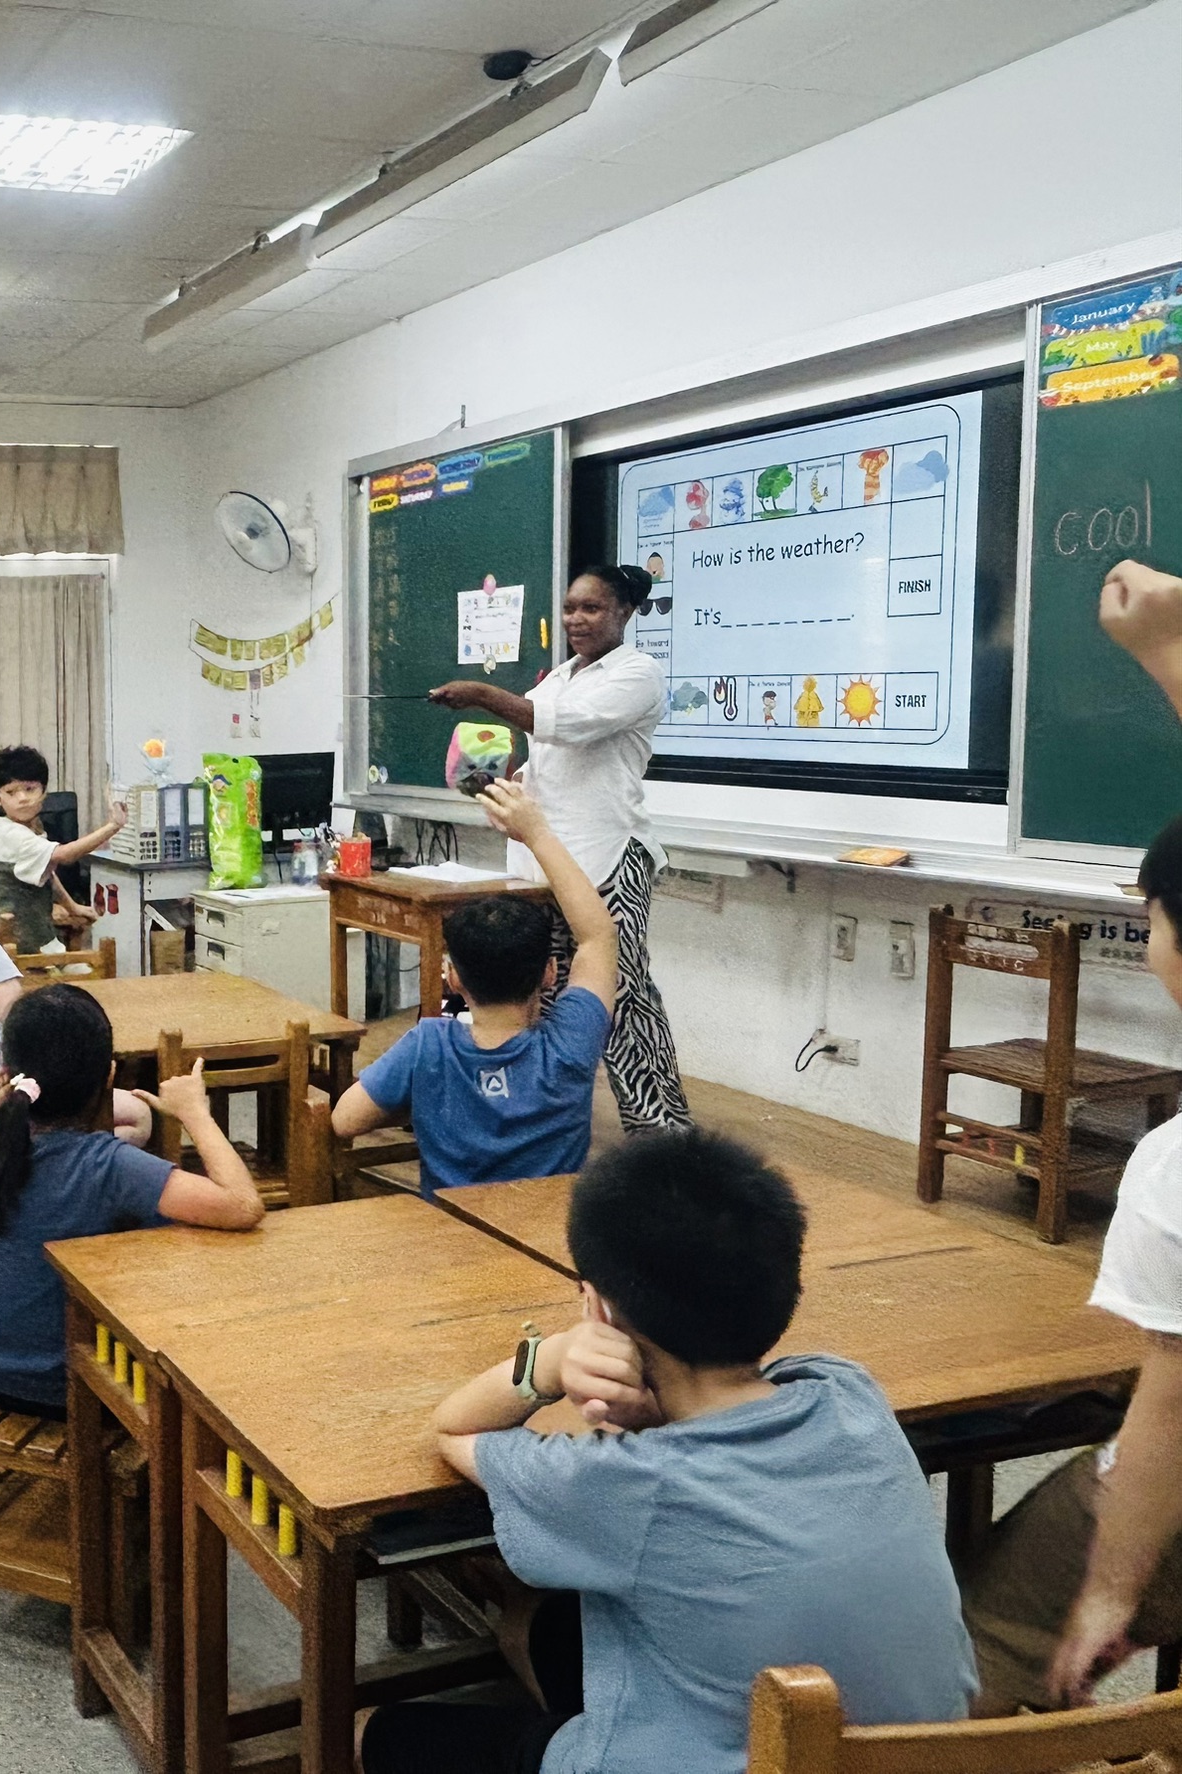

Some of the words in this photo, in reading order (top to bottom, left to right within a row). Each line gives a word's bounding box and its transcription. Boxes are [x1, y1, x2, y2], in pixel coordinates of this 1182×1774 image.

[1071, 302, 1136, 325] January
[1086, 340, 1119, 353] May
[1061, 370, 1160, 392] September
[692, 550, 724, 569] How
[729, 547, 742, 566] is
[748, 542, 775, 563] the
[780, 532, 865, 561] weather?
[898, 579, 932, 594] FINISH
[895, 694, 927, 708] START
[1020, 909, 1093, 940] Seeg
[1100, 919, 1117, 940] is
[1124, 921, 1151, 944] be
